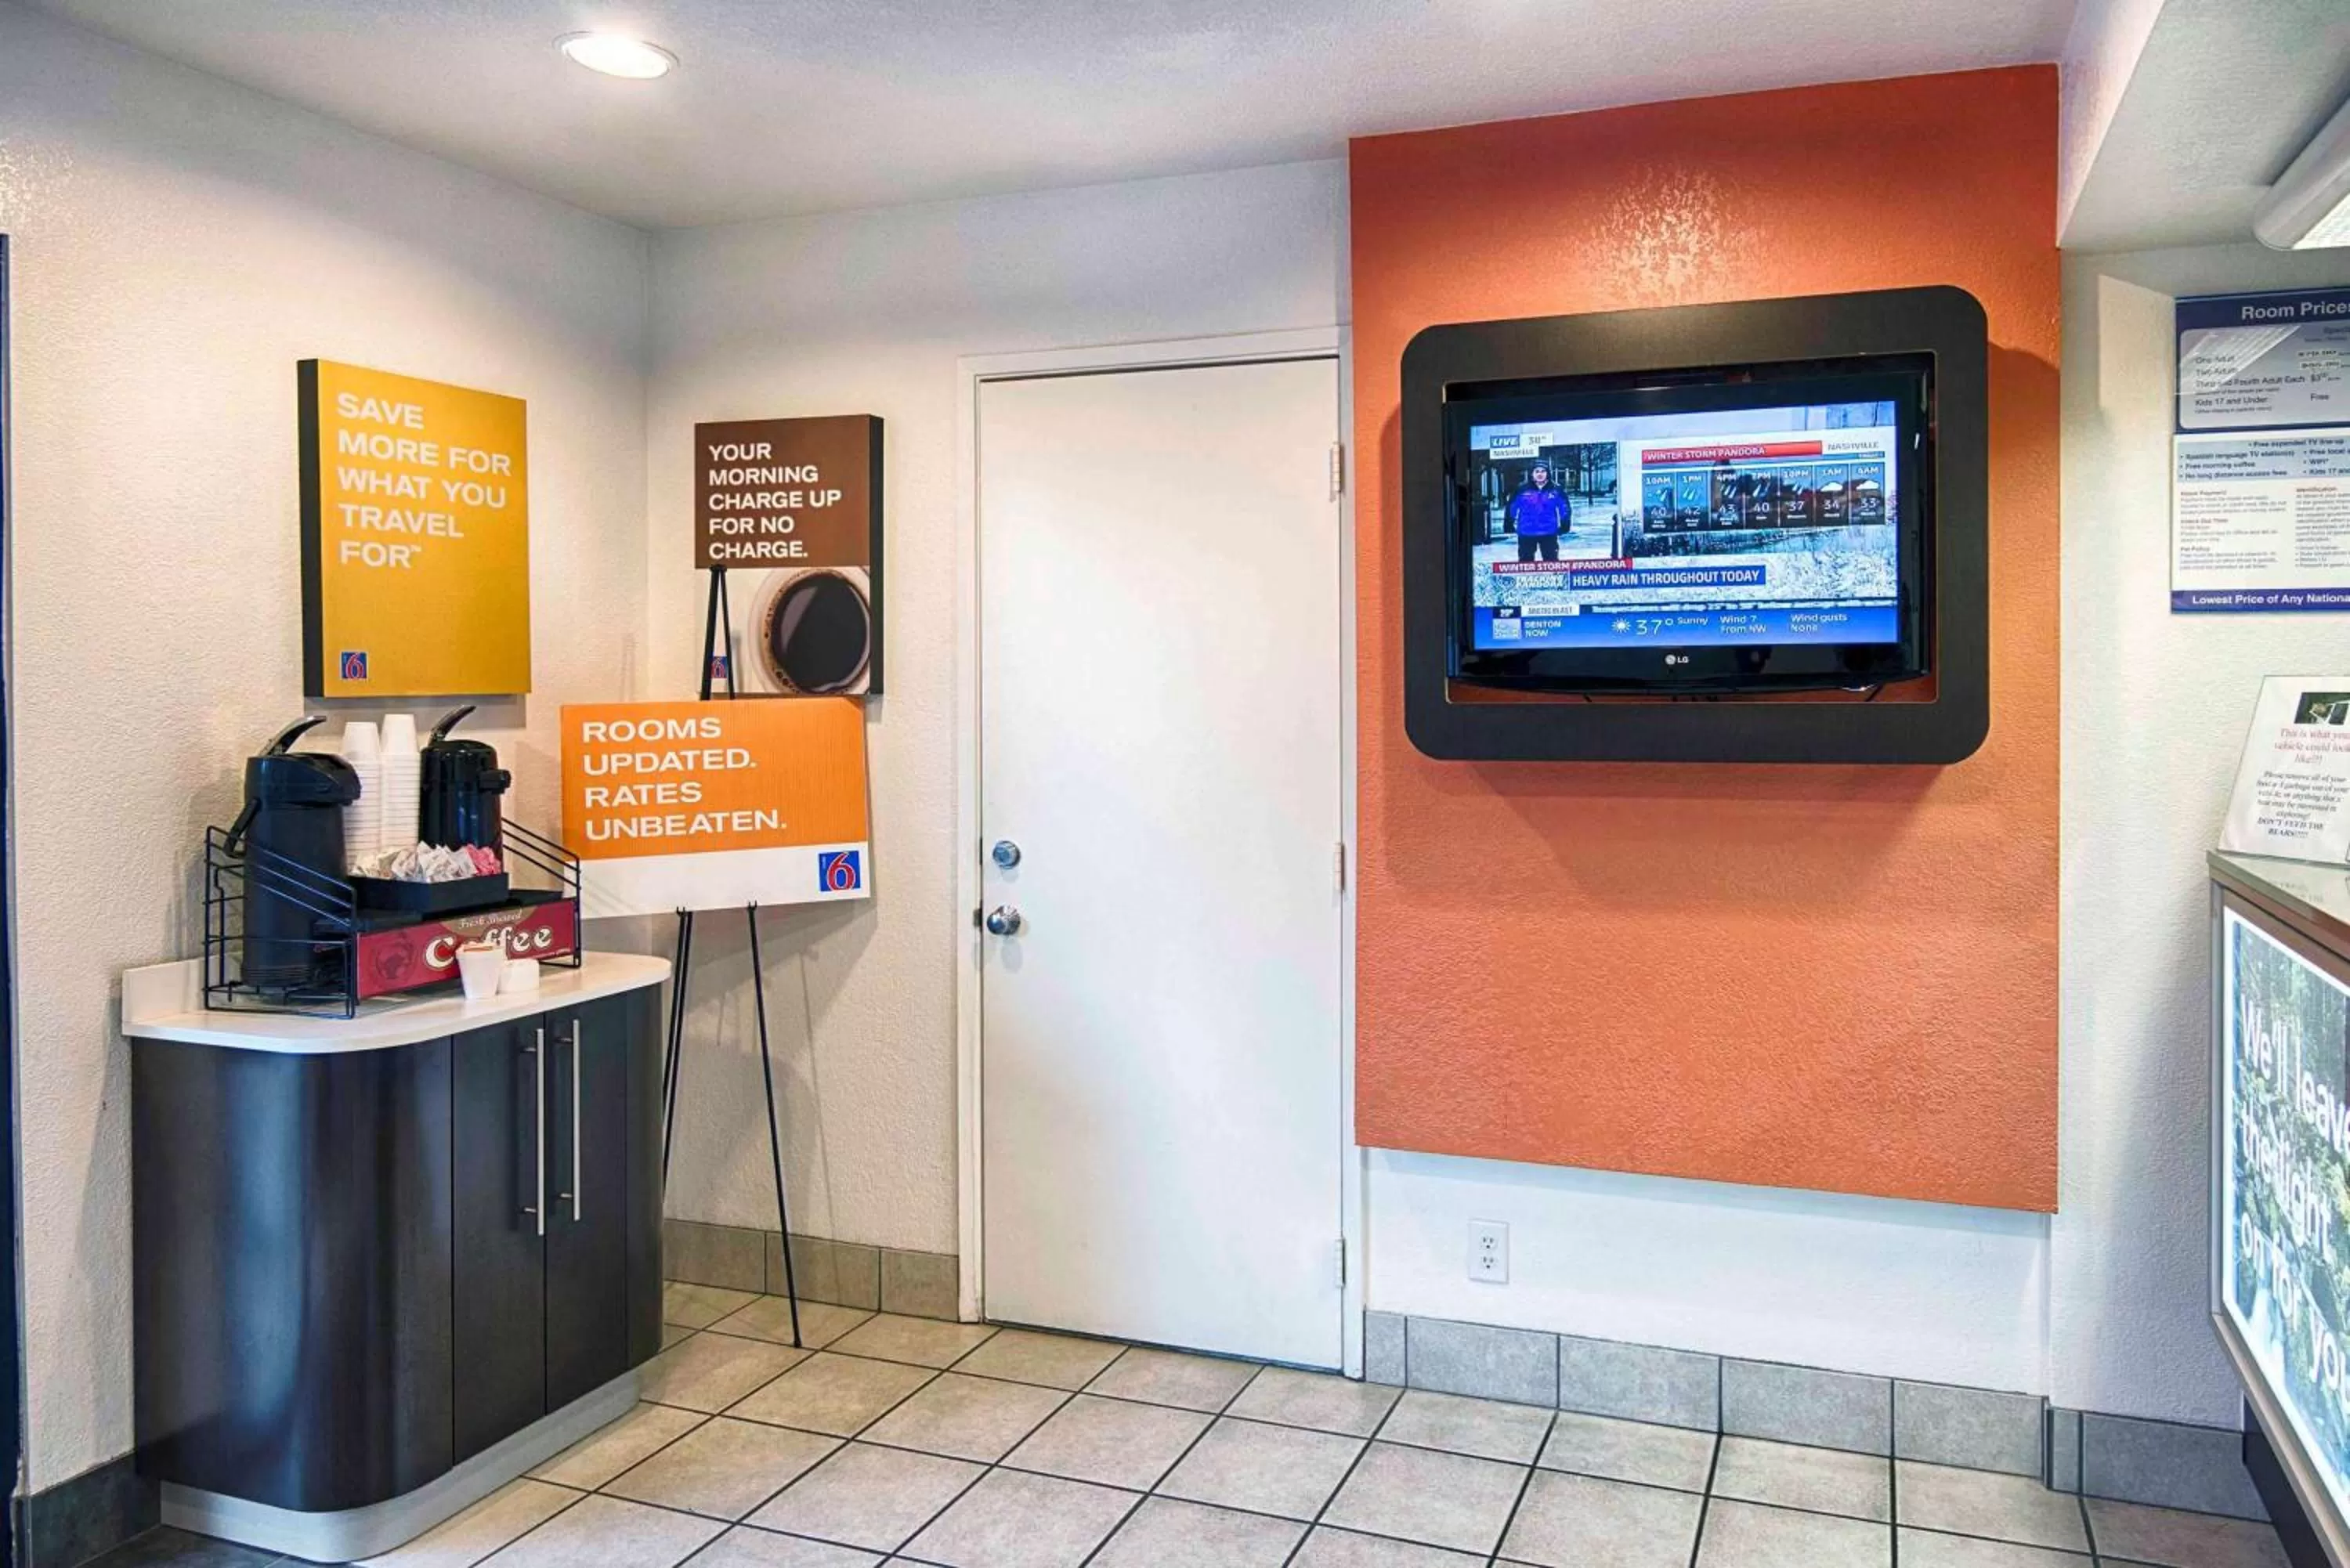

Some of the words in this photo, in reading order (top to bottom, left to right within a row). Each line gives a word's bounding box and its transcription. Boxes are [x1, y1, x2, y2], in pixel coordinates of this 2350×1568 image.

[2241, 305, 2294, 320] Room
[2301, 301, 2350, 316] Price
[2310, 392, 2330, 401] Free
[337, 393, 425, 430] SAVE
[708, 442, 772, 462] YOUR
[1491, 437, 1518, 447] LIVE
[1647, 451, 1683, 461] WINTER
[1684, 449, 1716, 459] STORM
[1719, 446, 1765, 457] PANDORA
[1828, 441, 1879, 451] NASHVILLE
[337, 430, 439, 468] MORE
[449, 446, 512, 477] FOR
[708, 464, 819, 486] MORNING
[1646, 476, 1672, 485] 10AM
[1683, 475, 1702, 483] 1PM
[338, 468, 431, 500] WHAT
[442, 479, 506, 509] YOU
[708, 491, 804, 511] CHARGE
[809, 490, 842, 508] UP
[1754, 502, 1770, 513] 40
[1788, 500, 1805, 511] 37
[338, 504, 465, 538] TRAVEL
[708, 517, 755, 536] FOR
[760, 515, 795, 534] NO
[708, 540, 809, 560] CHARGE.
[1499, 562, 1536, 573] WINTER
[1537, 562, 1570, 572] STORM
[1571, 559, 1626, 570] #PANDORA
[1573, 574, 1609, 587] HEAVY
[1611, 573, 1639, 586] RAIN
[1640, 570, 1720, 584] THROUGHOUT
[1721, 569, 1759, 583] TODAY
[2193, 594, 2232, 605] Lowest
[2234, 594, 2265, 605] Price
[2266, 594, 2279, 604] of
[2280, 593, 2304, 605] Any
[1525, 629, 1549, 638] NOW
[1720, 625, 1746, 634] From
[1791, 623, 1818, 632] None
[1635, 618, 1674, 636] 37°
[1677, 616, 1708, 626] Sunny
[1719, 615, 1747, 624] Wind
[1790, 613, 1818, 623] Wind
[1820, 612, 1848, 623] gusts
[1677, 655, 1690, 664] LG
[582, 716, 722, 743] ROOMS
[2310, 729, 2330, 739] what
[582, 747, 757, 776] UPDATED.
[584, 781, 703, 809] RATES
[585, 808, 787, 841] UNBEATEN.
[826, 852, 856, 891] 6
[425, 926, 553, 970] Cffee
[2241, 993, 2288, 1097] We'll
[2241, 1094, 2272, 1183] the
[2280, 1129, 2333, 1264] light
[2241, 1212, 2265, 1280] on
[2272, 1231, 2302, 1331] for
